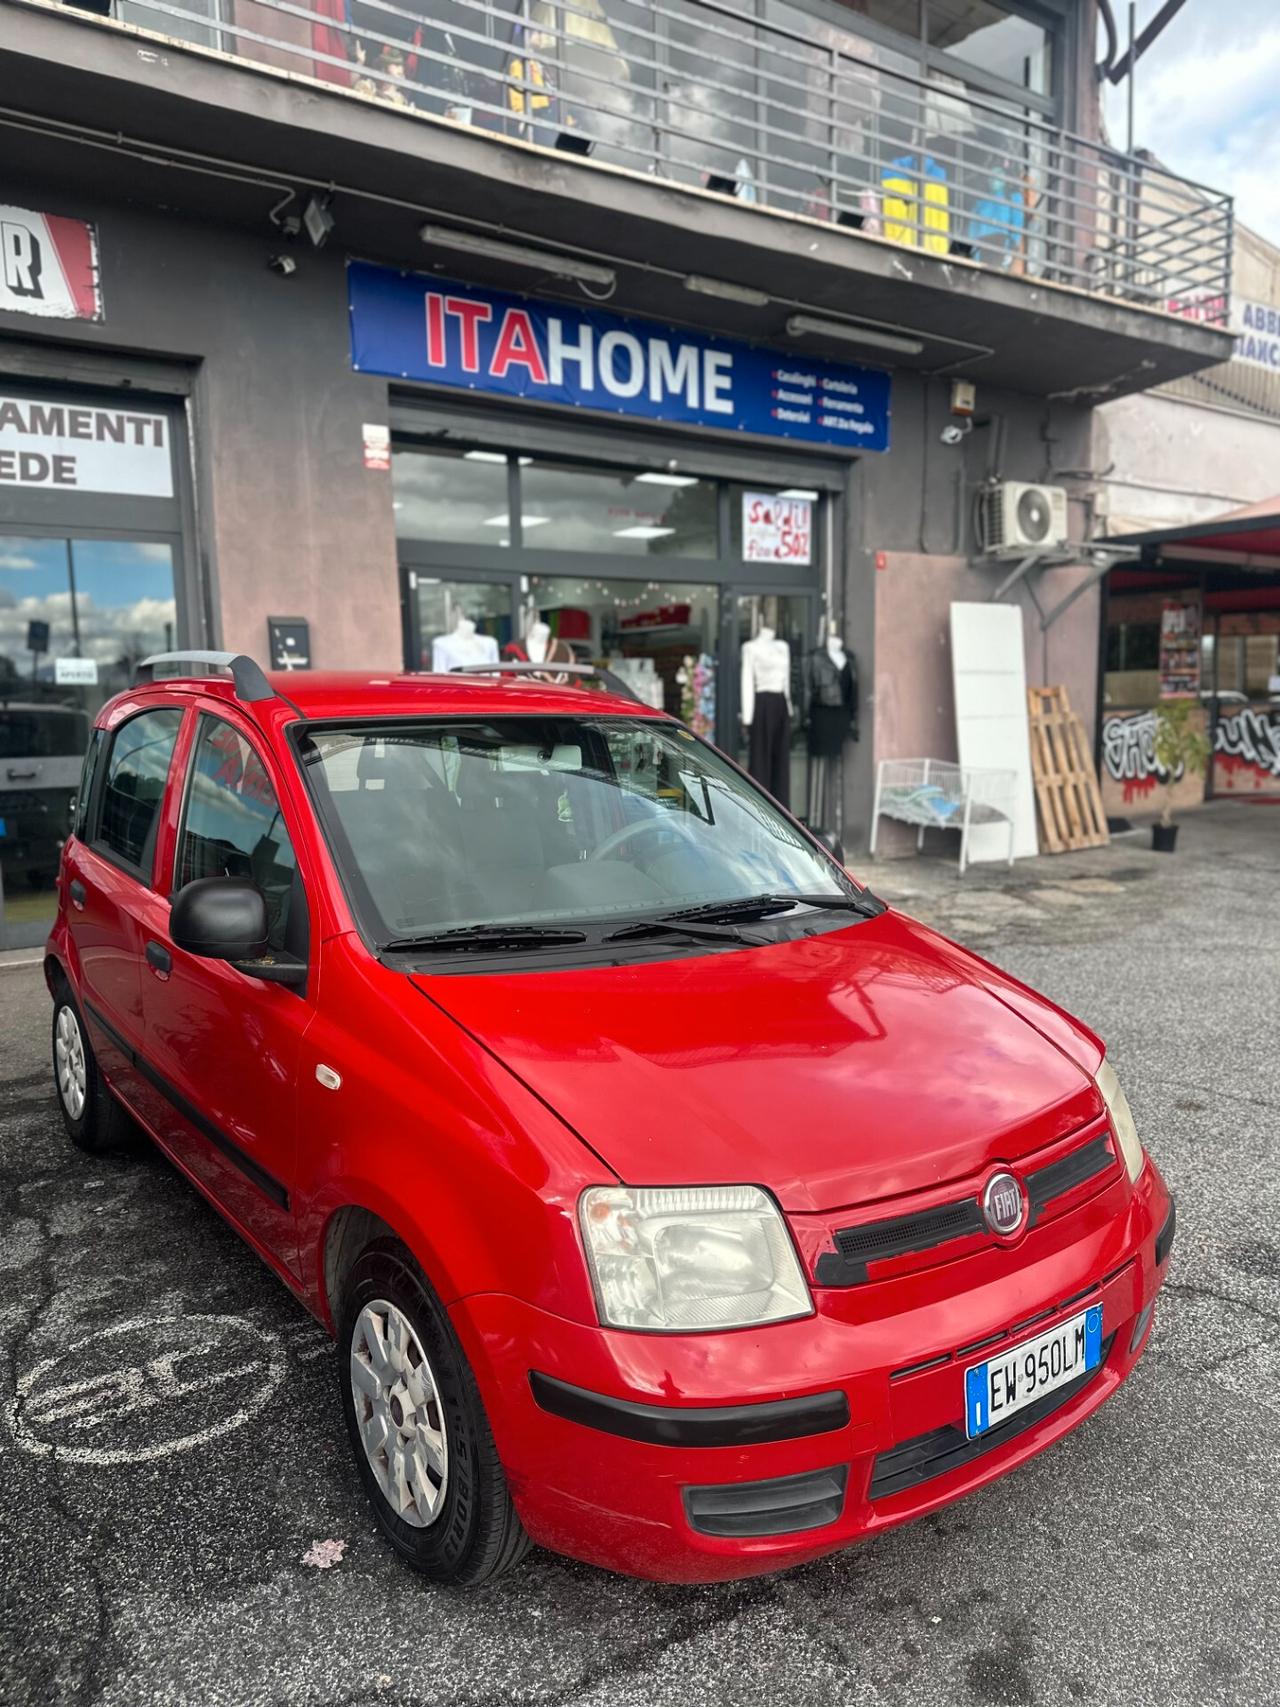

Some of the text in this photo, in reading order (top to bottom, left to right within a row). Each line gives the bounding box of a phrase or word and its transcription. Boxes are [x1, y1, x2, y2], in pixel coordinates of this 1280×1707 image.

[425, 291, 734, 416] ITAHOME
[994, 1188, 1017, 1221] FIAT
[990, 1324, 1085, 1412] EW 950LM
